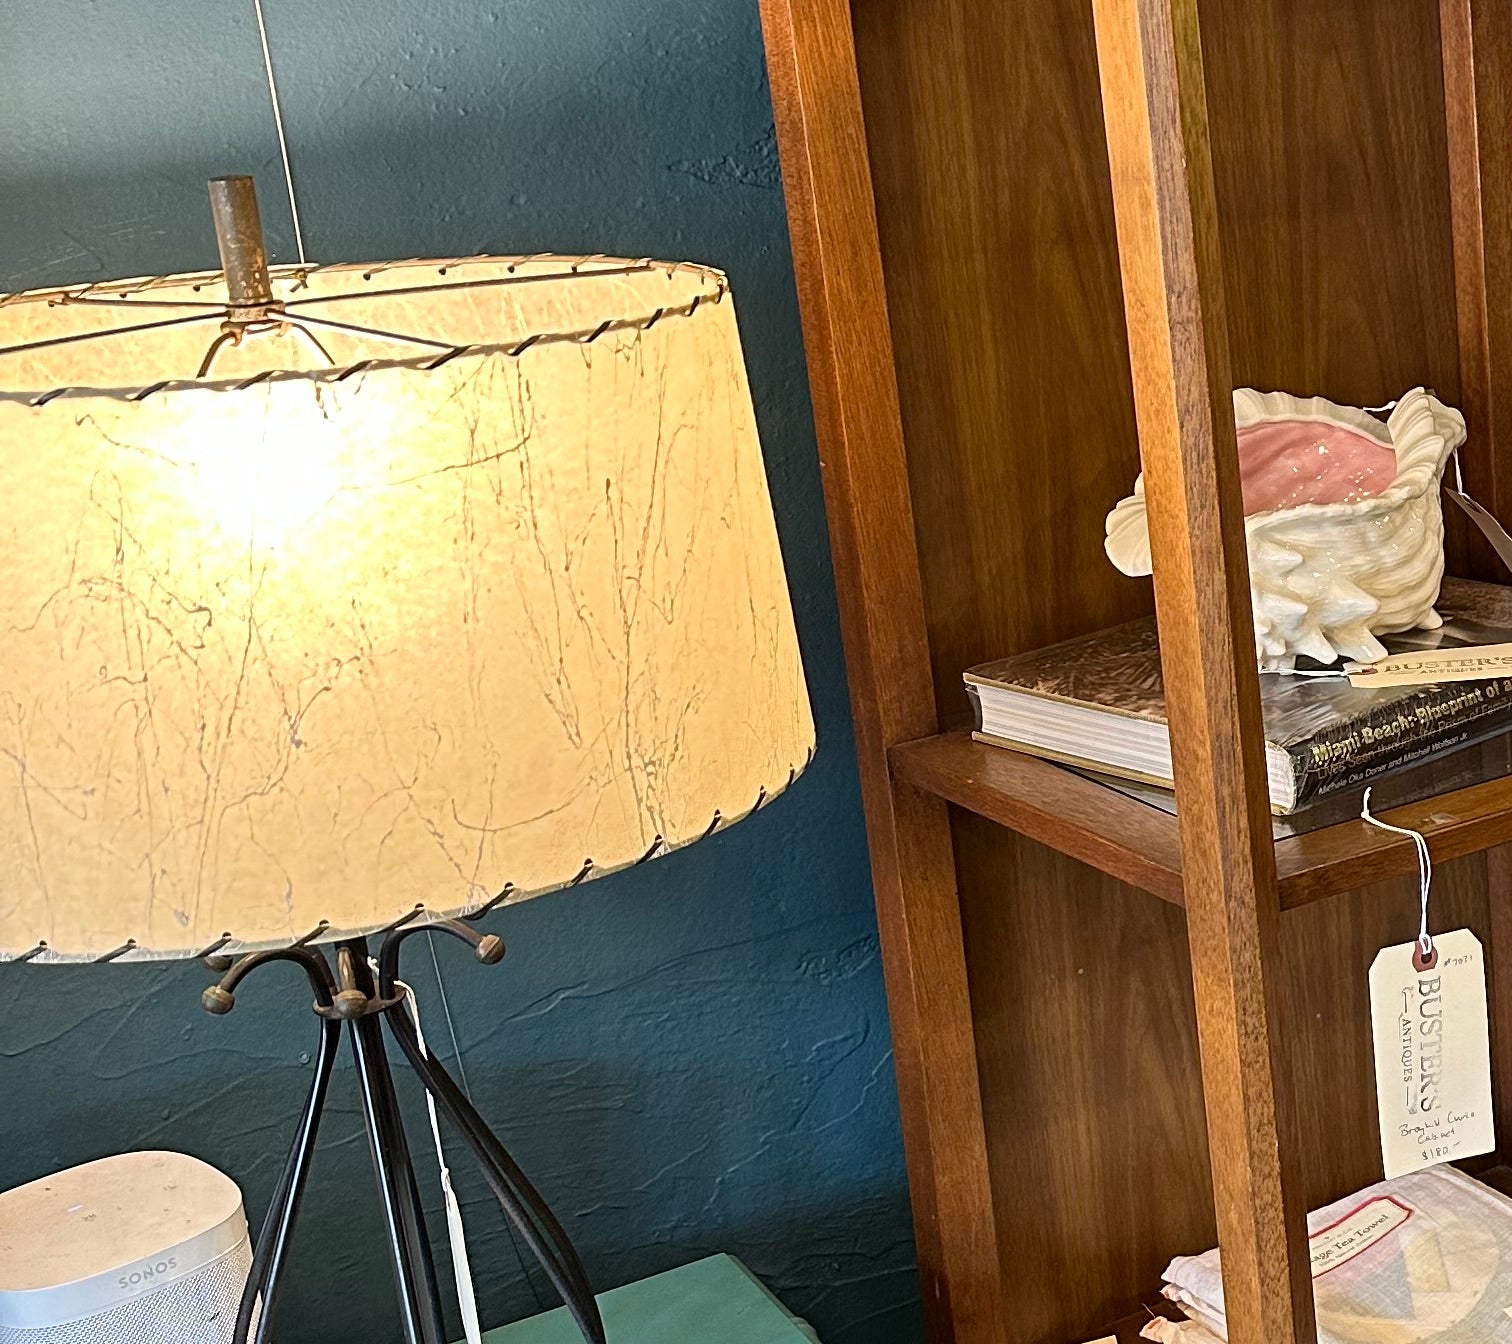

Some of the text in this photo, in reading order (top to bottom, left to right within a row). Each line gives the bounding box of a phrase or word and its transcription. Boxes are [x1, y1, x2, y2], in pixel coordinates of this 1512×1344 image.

[1311, 732, 1361, 763] Miami
[1415, 688, 1484, 722] Blueprint
[1485, 680, 1501, 698] of
[1401, 1018, 1413, 1083] ANTIQUES
[1418, 975, 1443, 1113] BUSTER'S
[1331, 1214, 1390, 1250] Tea Towel
[118, 1257, 177, 1289] SONOS
